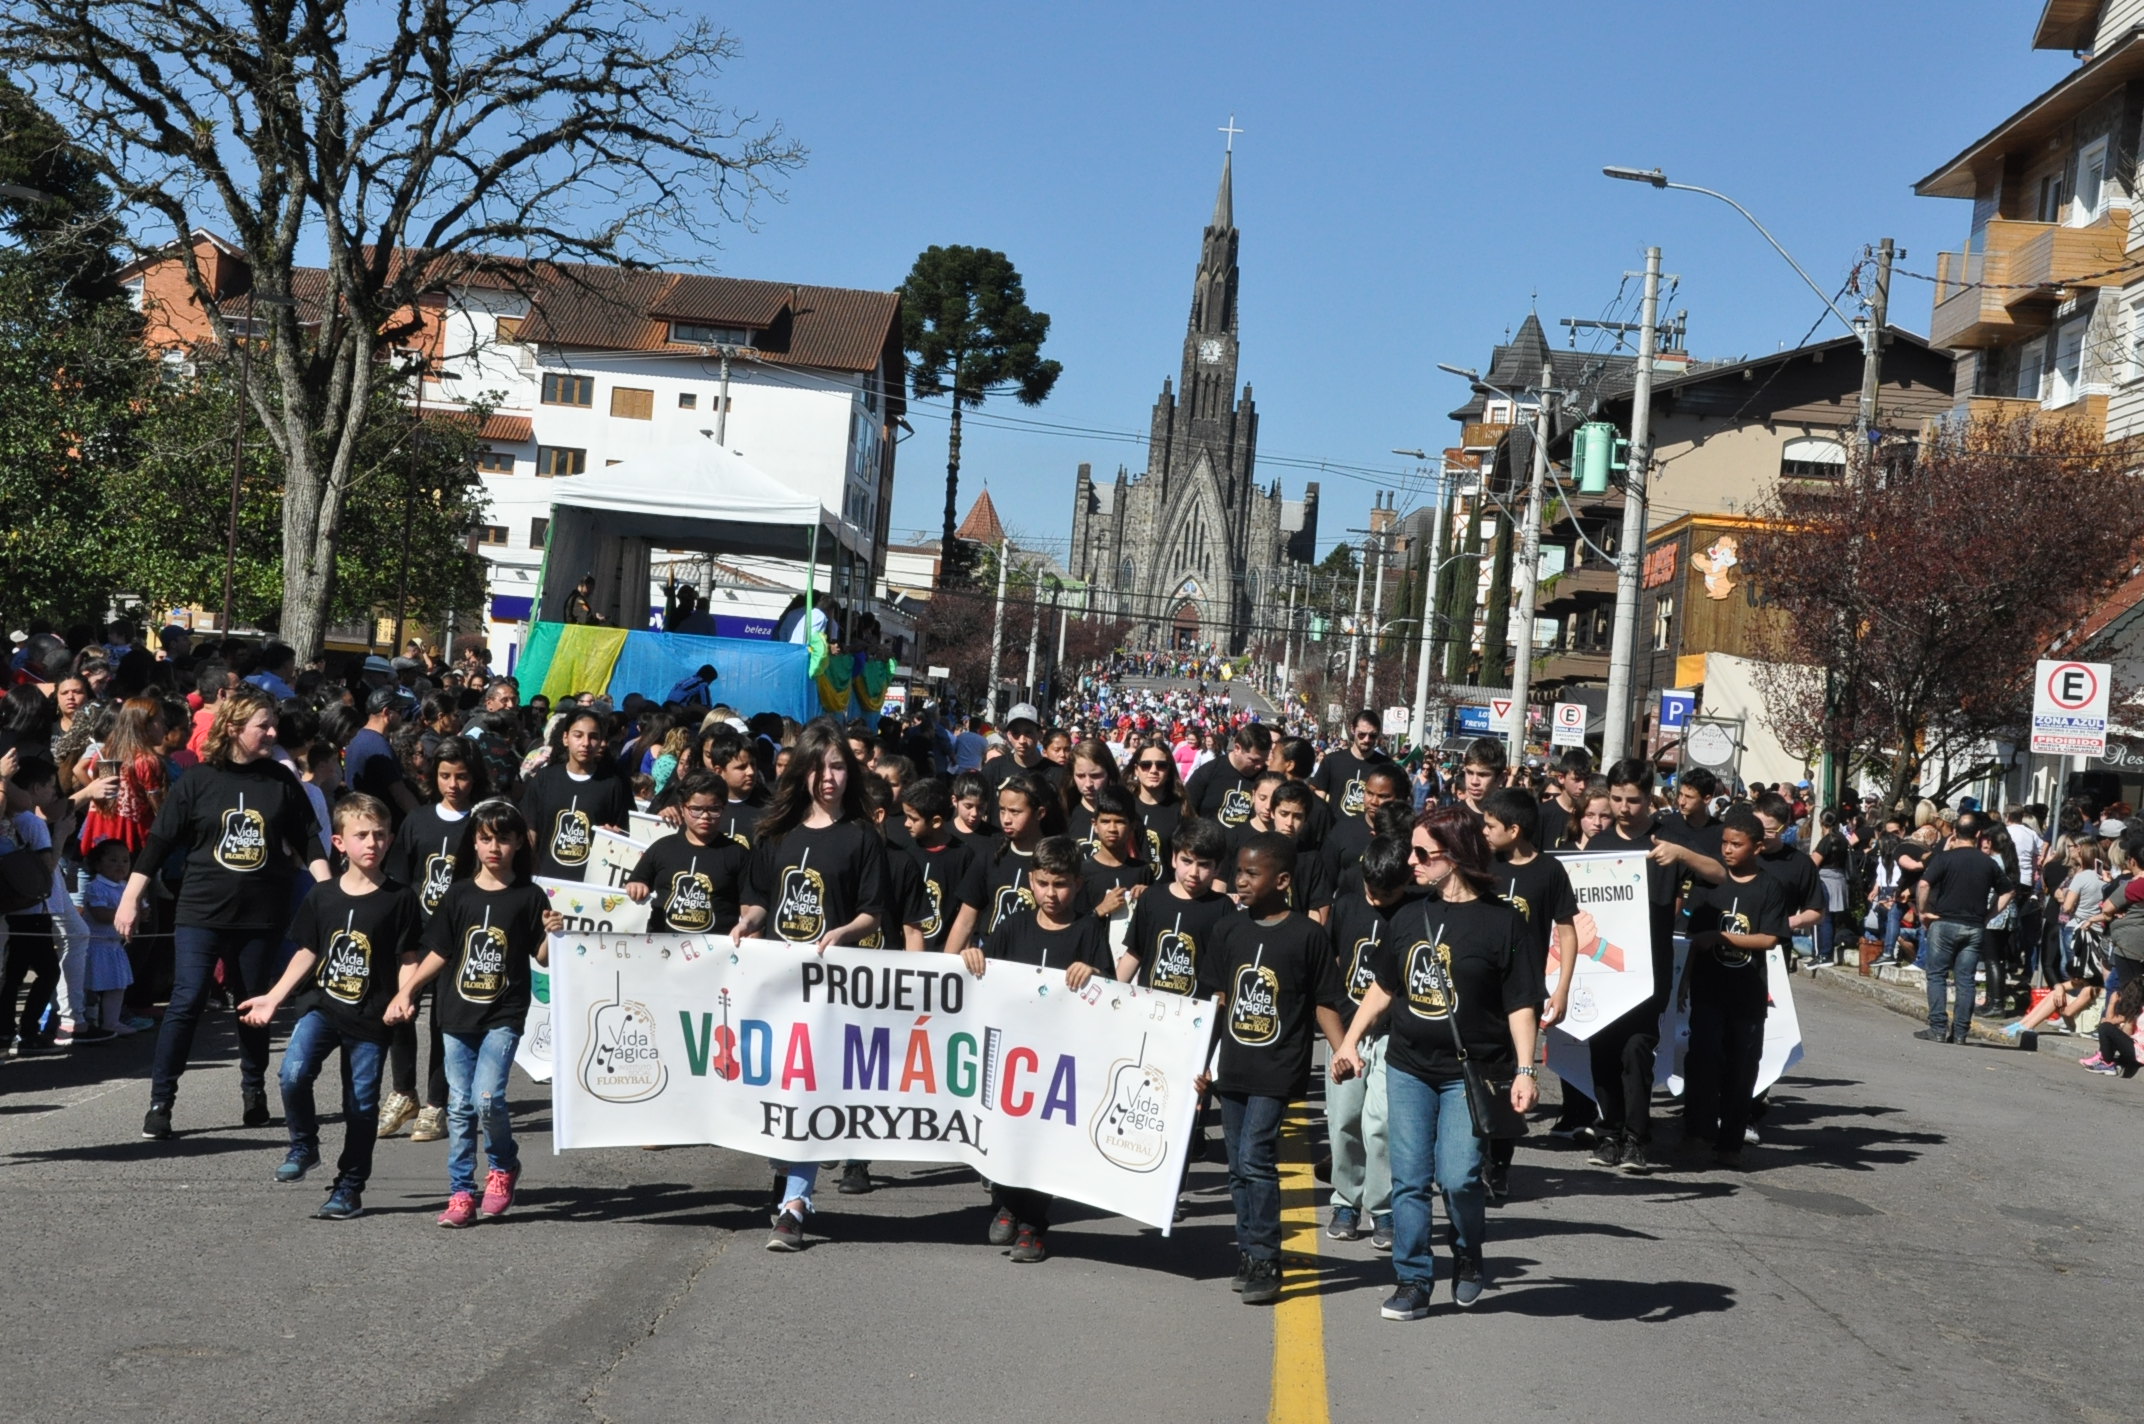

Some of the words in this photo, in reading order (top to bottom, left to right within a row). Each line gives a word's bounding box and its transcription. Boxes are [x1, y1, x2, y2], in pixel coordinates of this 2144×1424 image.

[744, 624, 772, 636] beleza
[2062, 671, 2085, 701] E
[1566, 709, 1575, 722] E
[1669, 701, 1684, 721] P
[1465, 720, 1488, 729] TREVO
[2036, 716, 2069, 726] ZONA
[2072, 718, 2104, 728] AZUL
[2037, 736, 2100, 746] PROIBIDO
[2101, 743, 2144, 767] Res
[1574, 884, 1634, 903] HEIRISMO
[802, 962, 963, 1014] PROJETO
[609, 1014, 648, 1046] Vida
[597, 1076, 652, 1085] FLORYBAL
[1127, 1079, 1159, 1115] Vida
[760, 1101, 988, 1155] FLORYBAL
[1105, 1135, 1153, 1157] FLORYBAL
